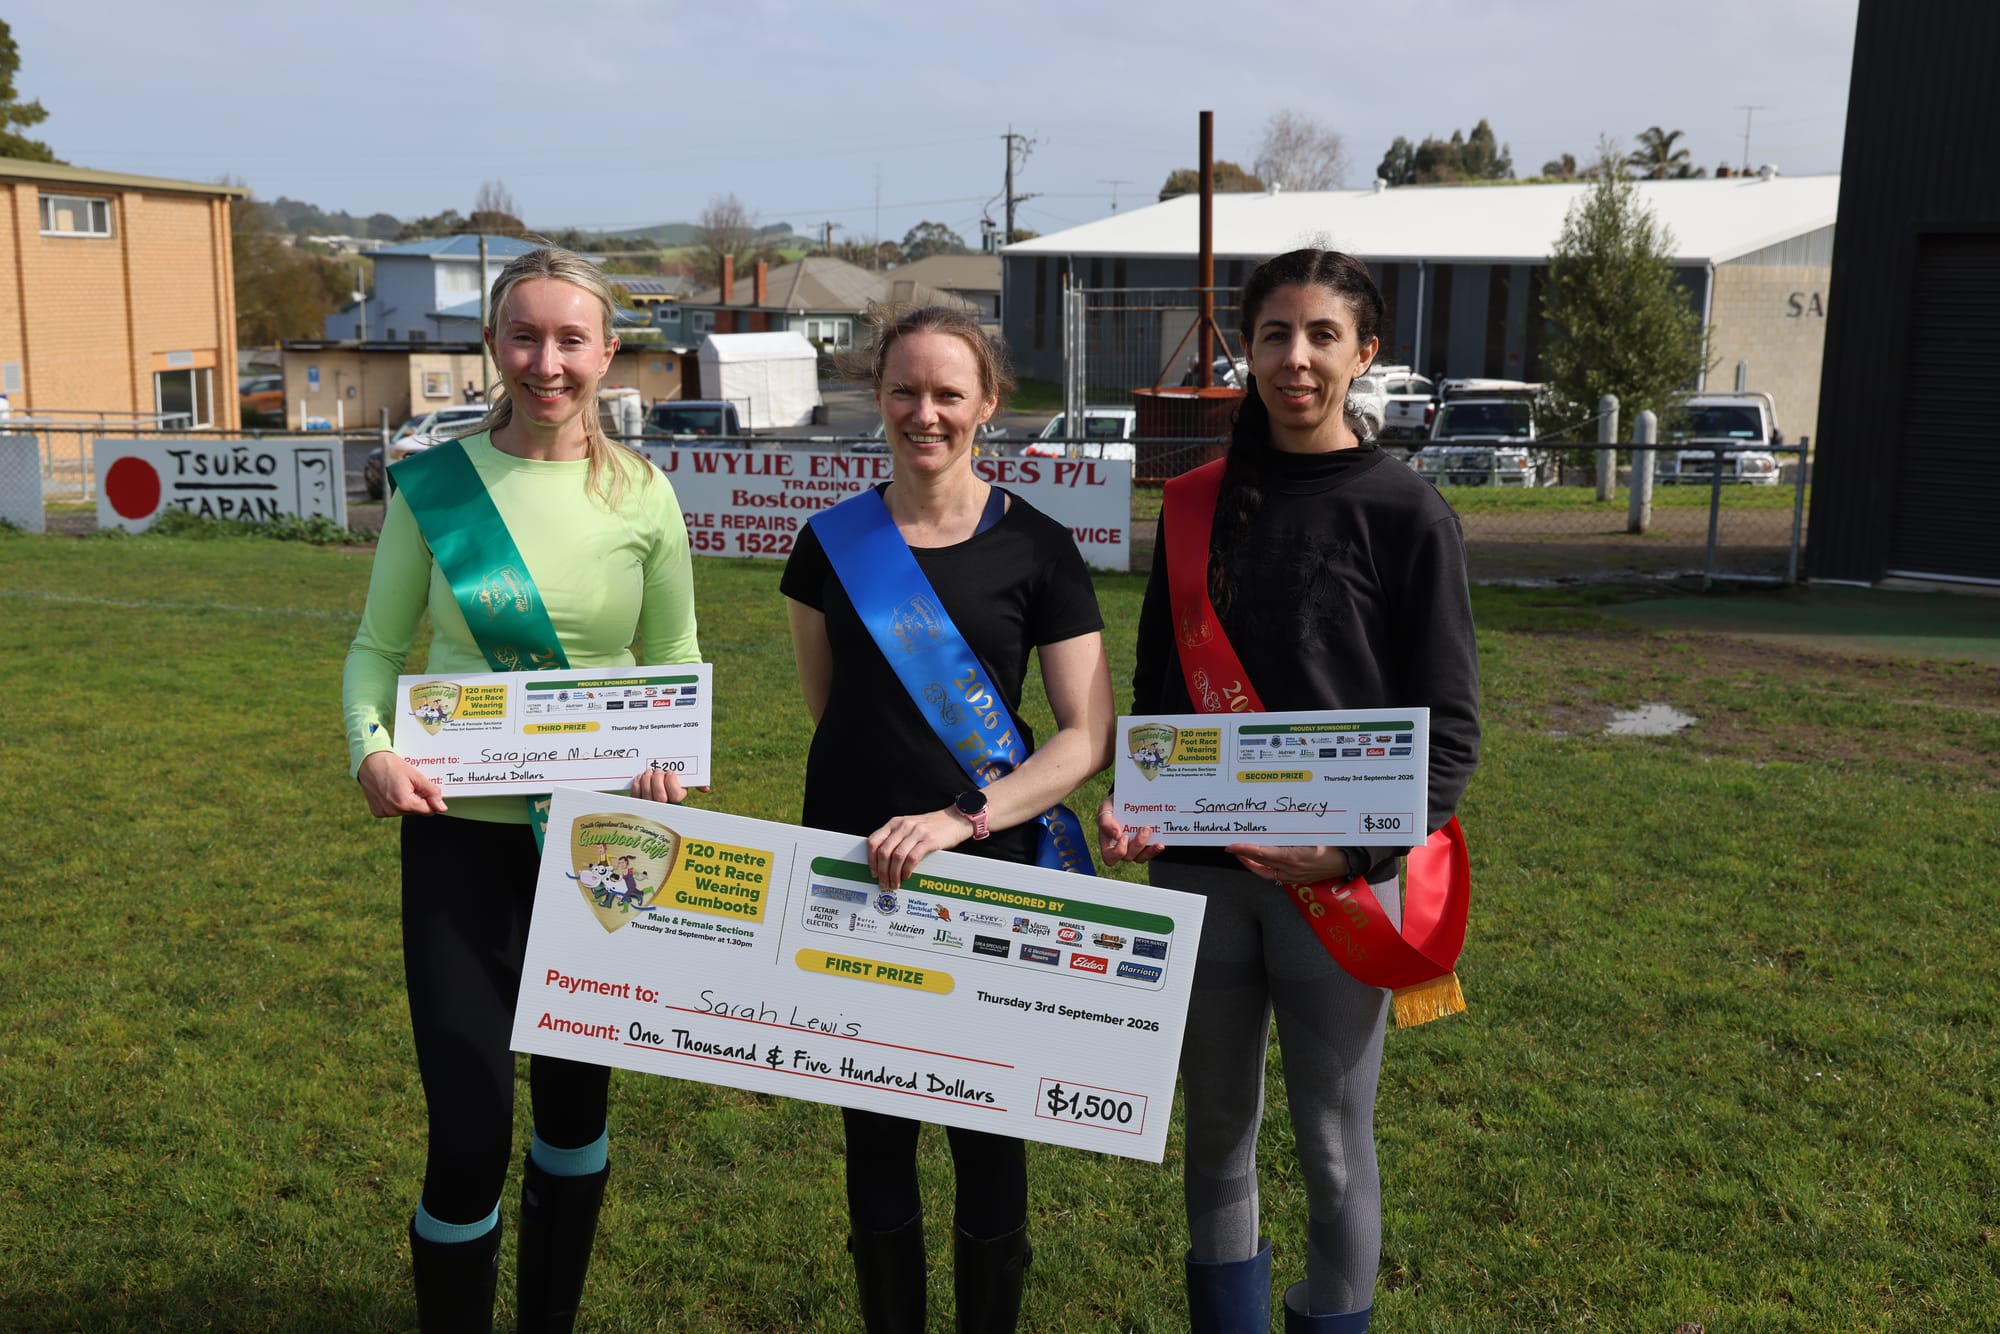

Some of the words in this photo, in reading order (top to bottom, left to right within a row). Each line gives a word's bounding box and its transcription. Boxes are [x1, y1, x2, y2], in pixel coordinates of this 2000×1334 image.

[693, 451, 794, 476] WYLIE
[1054, 461, 1107, 488] P/L
[781, 479, 861, 492] TRADING
[721, 514, 798, 531] REPAIRS
[736, 533, 793, 555] 1522
[578, 680, 604, 688] PROUDLY
[953, 668, 1003, 730] 2026
[650, 723, 682, 731] September
[1186, 746, 1217, 754] Wearing
[448, 756, 460, 764] to:
[480, 747, 558, 768] Sarajane
[650, 759, 686, 773] $200
[446, 773, 464, 783] Two
[468, 772, 506, 782] Hundred
[511, 771, 545, 780] Dollars
[1280, 772, 1304, 780] PRIZE
[1364, 774, 1396, 782] September
[1124, 803, 1162, 814] Payment
[1165, 804, 1176, 812] to:
[1194, 797, 1267, 814] Samantha
[1273, 796, 1328, 818] Sherry
[1164, 822, 1190, 832] Three
[1194, 821, 1231, 832] Hundred
[1234, 822, 1267, 832] Dollars
[1364, 816, 1401, 833] $300
[578, 828, 641, 848] Gumboot
[640, 837, 670, 860] Gift
[686, 843, 715, 858] 120
[719, 850, 766, 867] metre
[684, 859, 720, 876] Foot
[725, 866, 763, 883] Race
[695, 877, 760, 902] Wearing
[920, 879, 973, 897] PROUDLY
[975, 888, 1046, 908] SPONSORED
[1048, 901, 1064, 912] BY
[675, 891, 758, 916] Gumboots
[907, 904, 933, 913] Electrical
[908, 898, 928, 907] Walker
[810, 905, 839, 916] LECTAIRE
[906, 910, 938, 920] Contracting
[648, 912, 671, 924] Male
[672, 916, 679, 925] &
[681, 918, 714, 931] Female
[716, 924, 754, 938] Sections
[806, 920, 839, 930] ELECTRICS
[976, 914, 998, 922] LEVEY
[889, 922, 925, 935] Nutrien
[1029, 926, 1050, 936] depot
[1033, 922, 1048, 930] farm
[1059, 922, 1085, 931] MICHAEL'S
[631, 921, 663, 934] Thursday
[678, 930, 716, 942] September
[727, 938, 753, 948] 1.30pm
[1060, 930, 1074, 939] IGA
[824, 956, 872, 976] FIRST
[876, 964, 924, 986] PRIZE
[1073, 957, 1104, 971] Elders
[1120, 964, 1159, 977] Marriotts
[546, 969, 630, 999] Payment
[635, 986, 660, 1003] to:
[694, 990, 778, 1023] Sarah
[790, 1006, 862, 1037] Lewis
[977, 991, 1032, 1012] Thursday
[1034, 1001, 1055, 1014] 3rd
[1058, 1005, 1124, 1026] September
[1126, 1017, 1159, 1032] 2026
[537, 1012, 620, 1041] Amount:
[629, 1022, 664, 1045] One
[672, 1029, 756, 1061] Thousand
[766, 1046, 784, 1070] &
[793, 1050, 832, 1074] Five
[840, 1057, 917, 1090] Hundred
[926, 1074, 994, 1103] Dollars
[1048, 1083, 1132, 1124] $1,500
